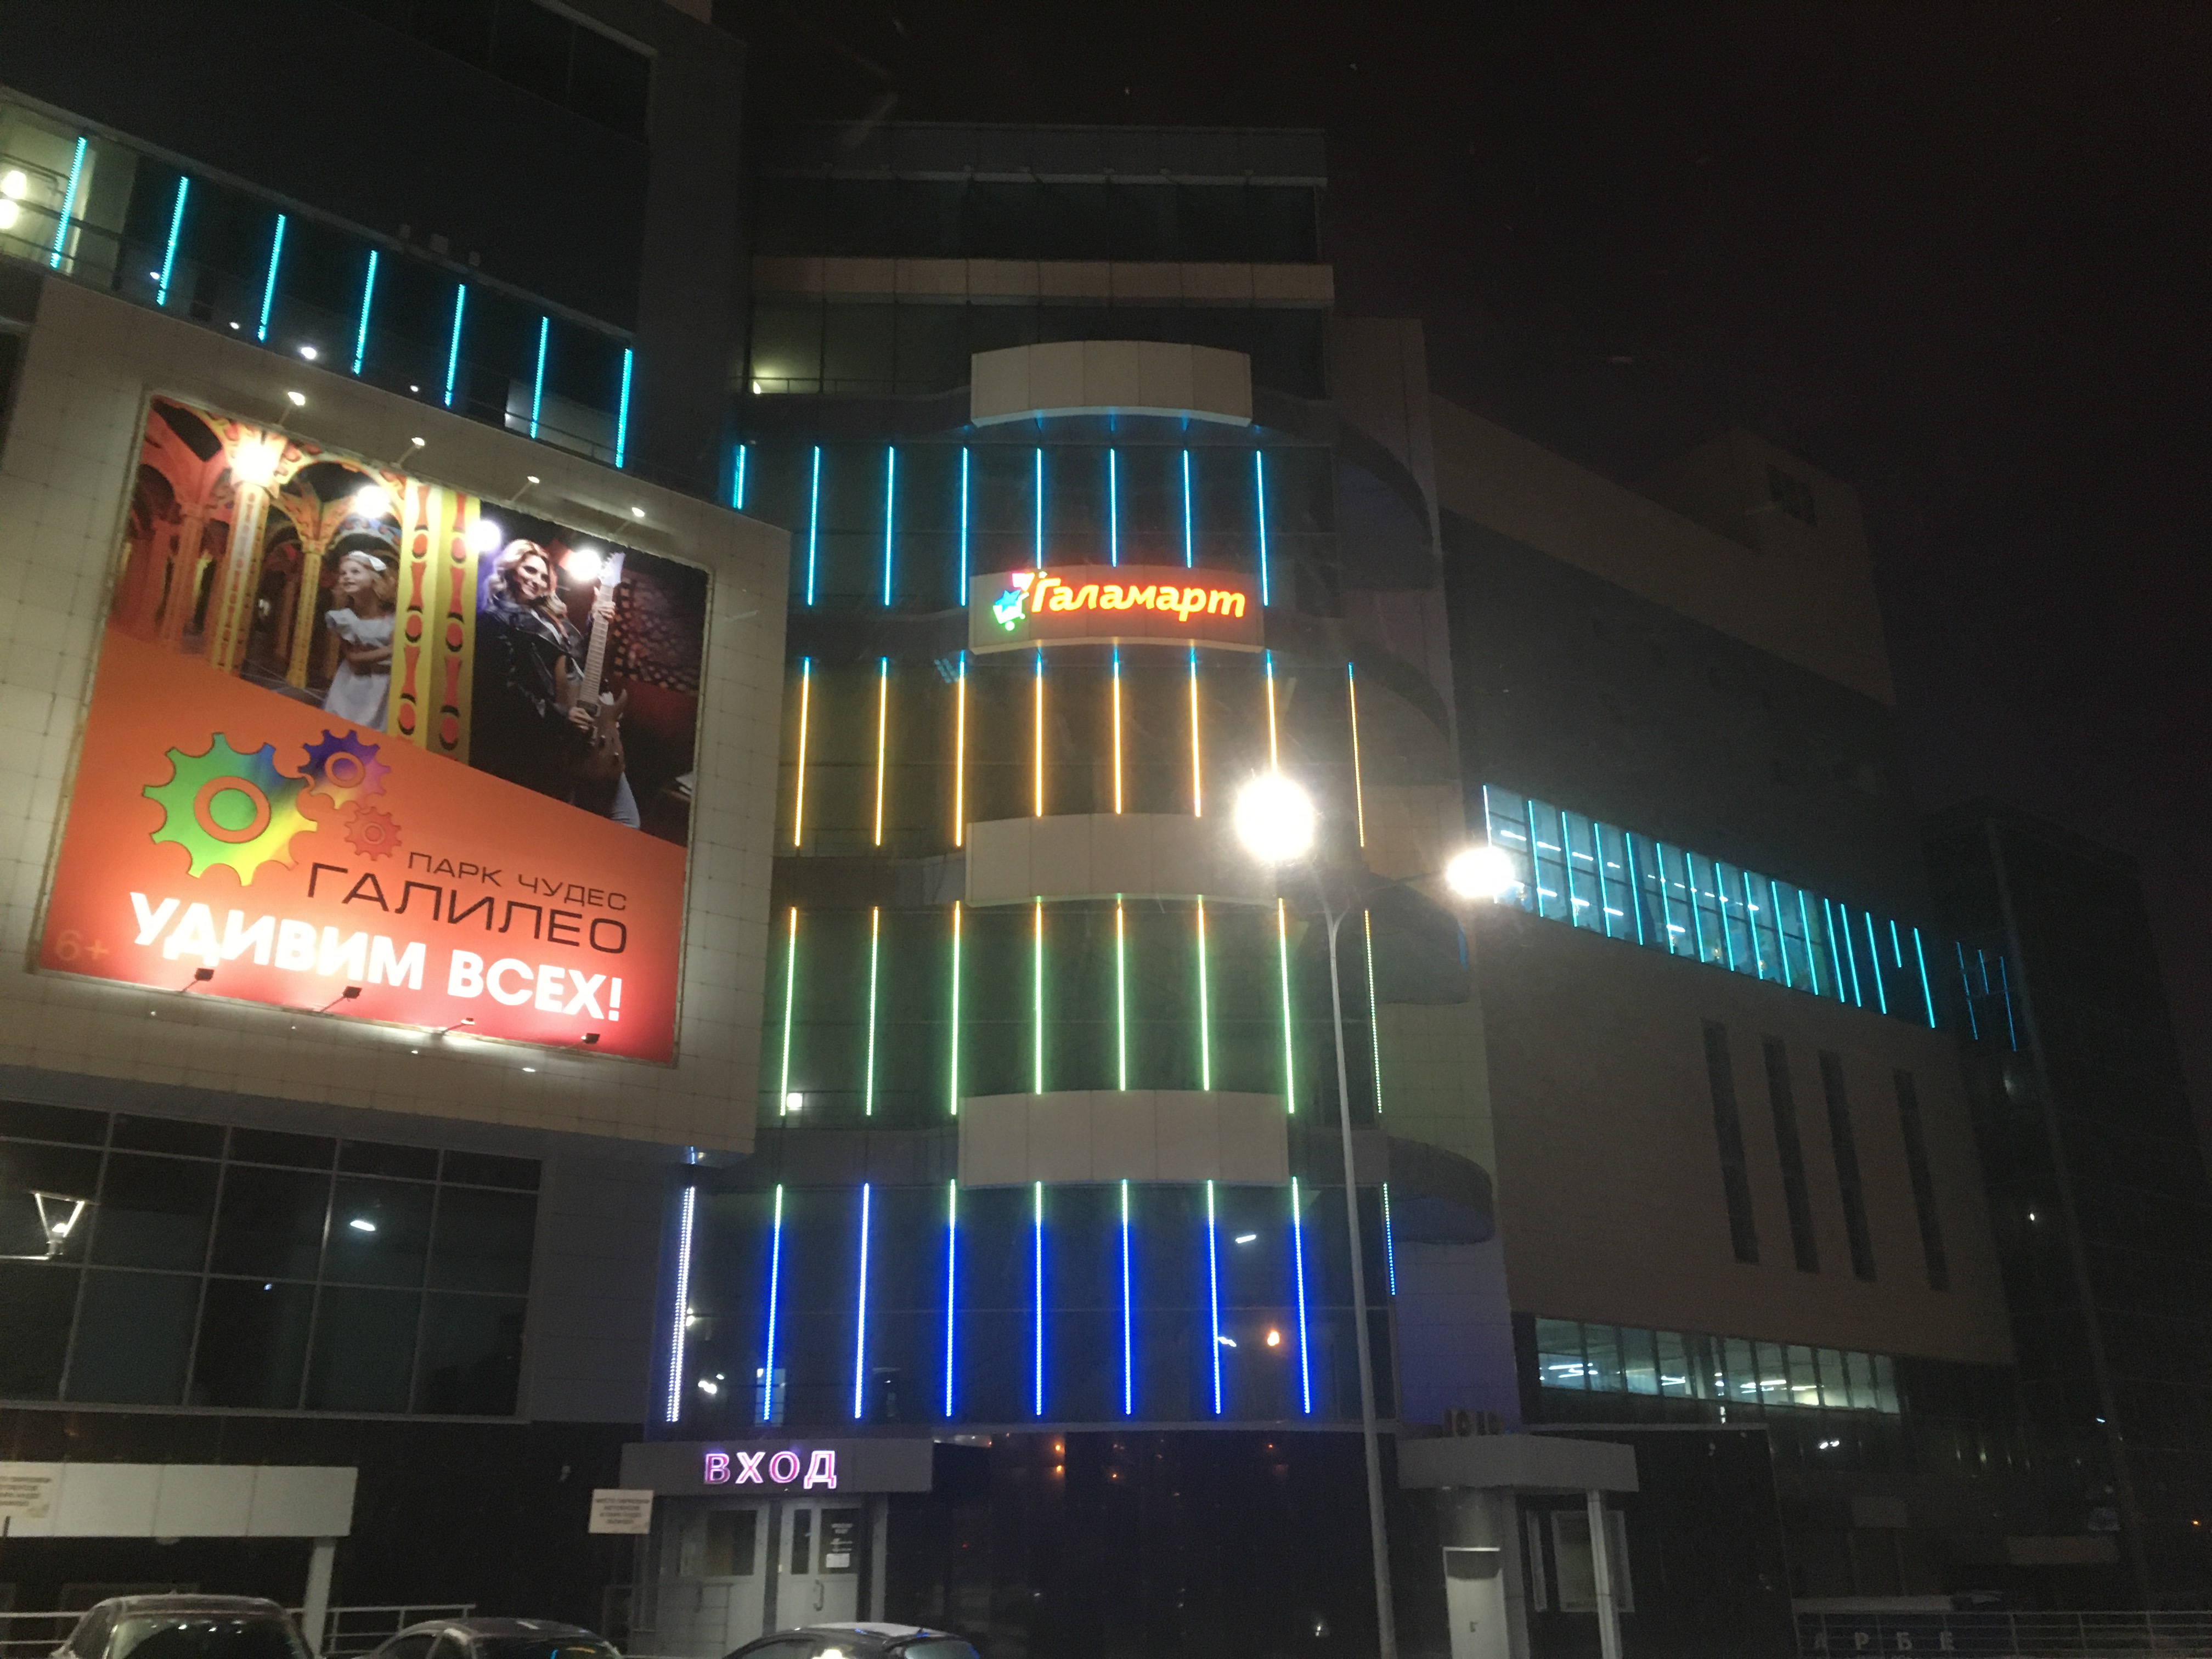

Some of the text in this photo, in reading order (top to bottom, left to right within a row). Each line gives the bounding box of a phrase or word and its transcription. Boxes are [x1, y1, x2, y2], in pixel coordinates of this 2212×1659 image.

[1031, 577, 1245, 622] Галамарт
[307, 861, 628, 954] ГАЛИЛЕО
[407, 851, 628, 912] ПАРК ЧУДЕС
[54, 928, 110, 964] 6+
[129, 891, 624, 1023] УДИВИМ ВСЕХ!
[703, 1449, 838, 1489] ВХОД
